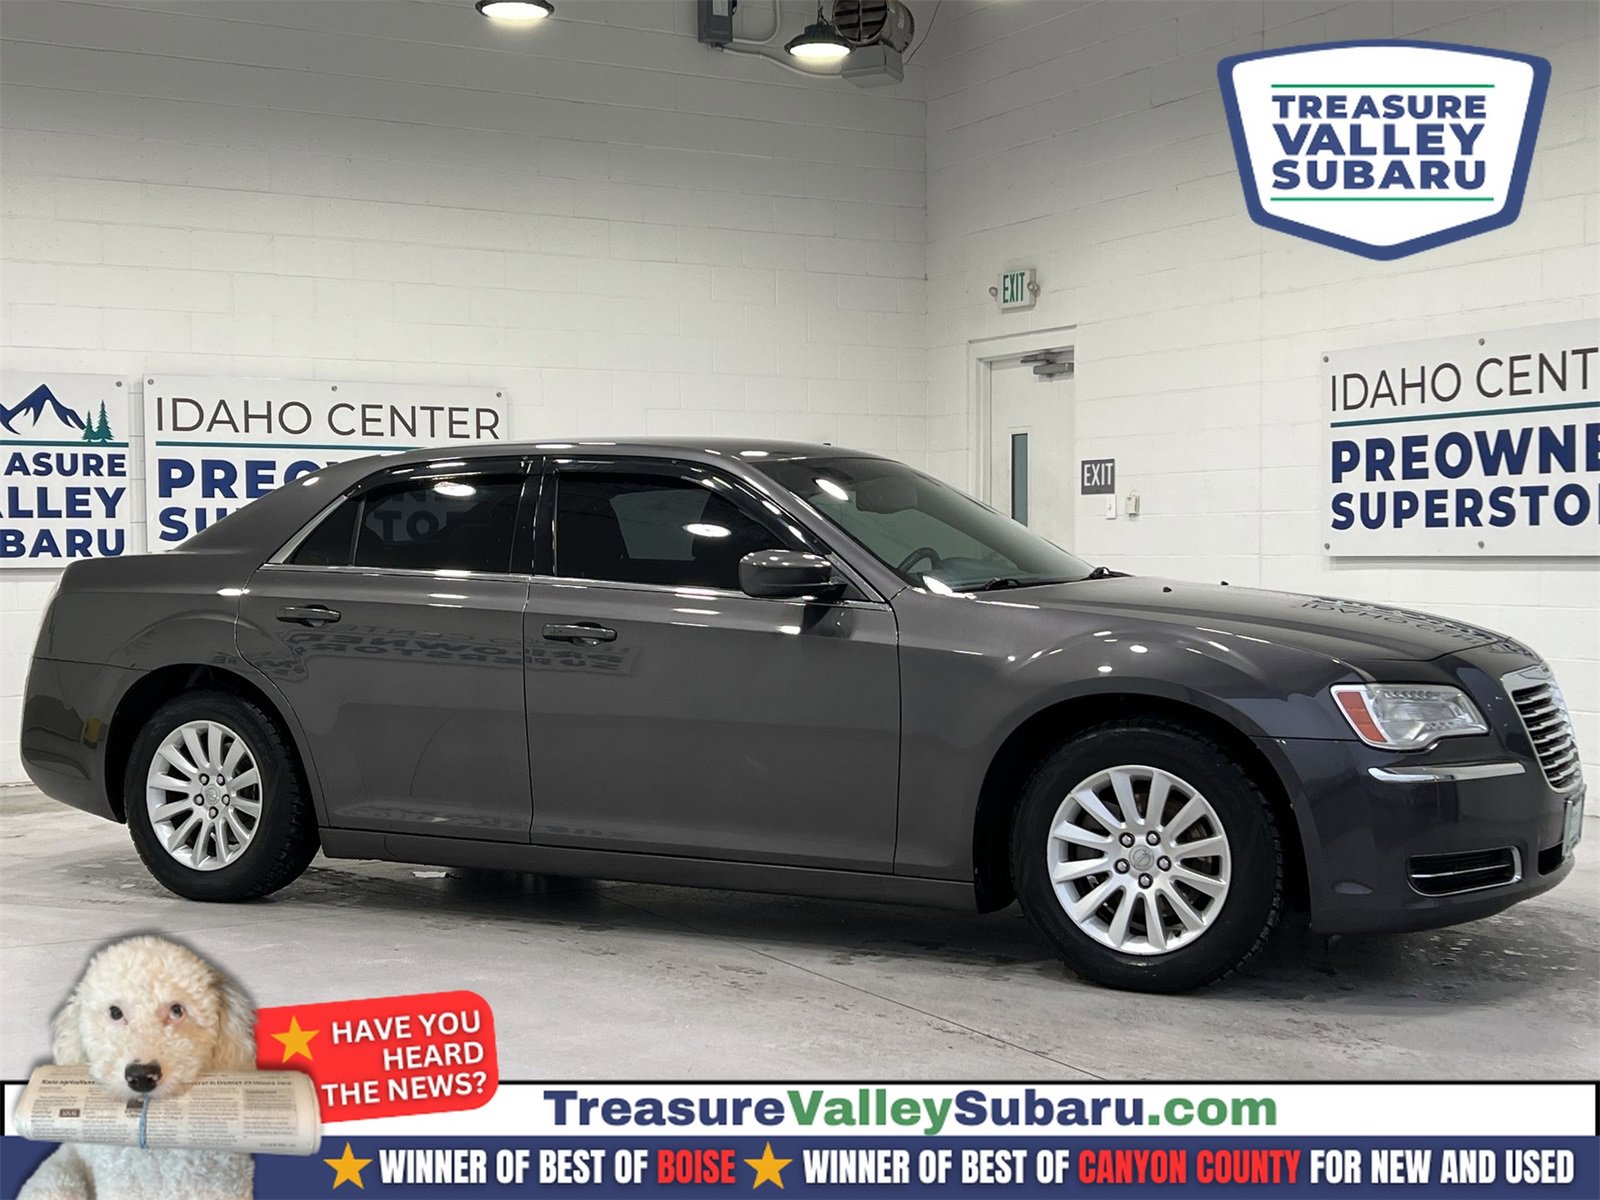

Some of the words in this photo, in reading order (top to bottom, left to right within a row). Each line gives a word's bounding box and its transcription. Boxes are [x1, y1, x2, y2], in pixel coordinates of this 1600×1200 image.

[1002, 271, 1026, 304] EXIT
[1331, 362, 1462, 412] IDAHO
[1476, 347, 1599, 399] CENT
[156, 397, 312, 435] IDAHO
[327, 402, 500, 440] CENTER
[3, 452, 127, 477] ASURE
[1083, 461, 1114, 487] EXIT
[0, 486, 127, 519] LLEY
[1331, 483, 1600, 531] SUPERSTO
[0, 528, 125, 558] BARU
